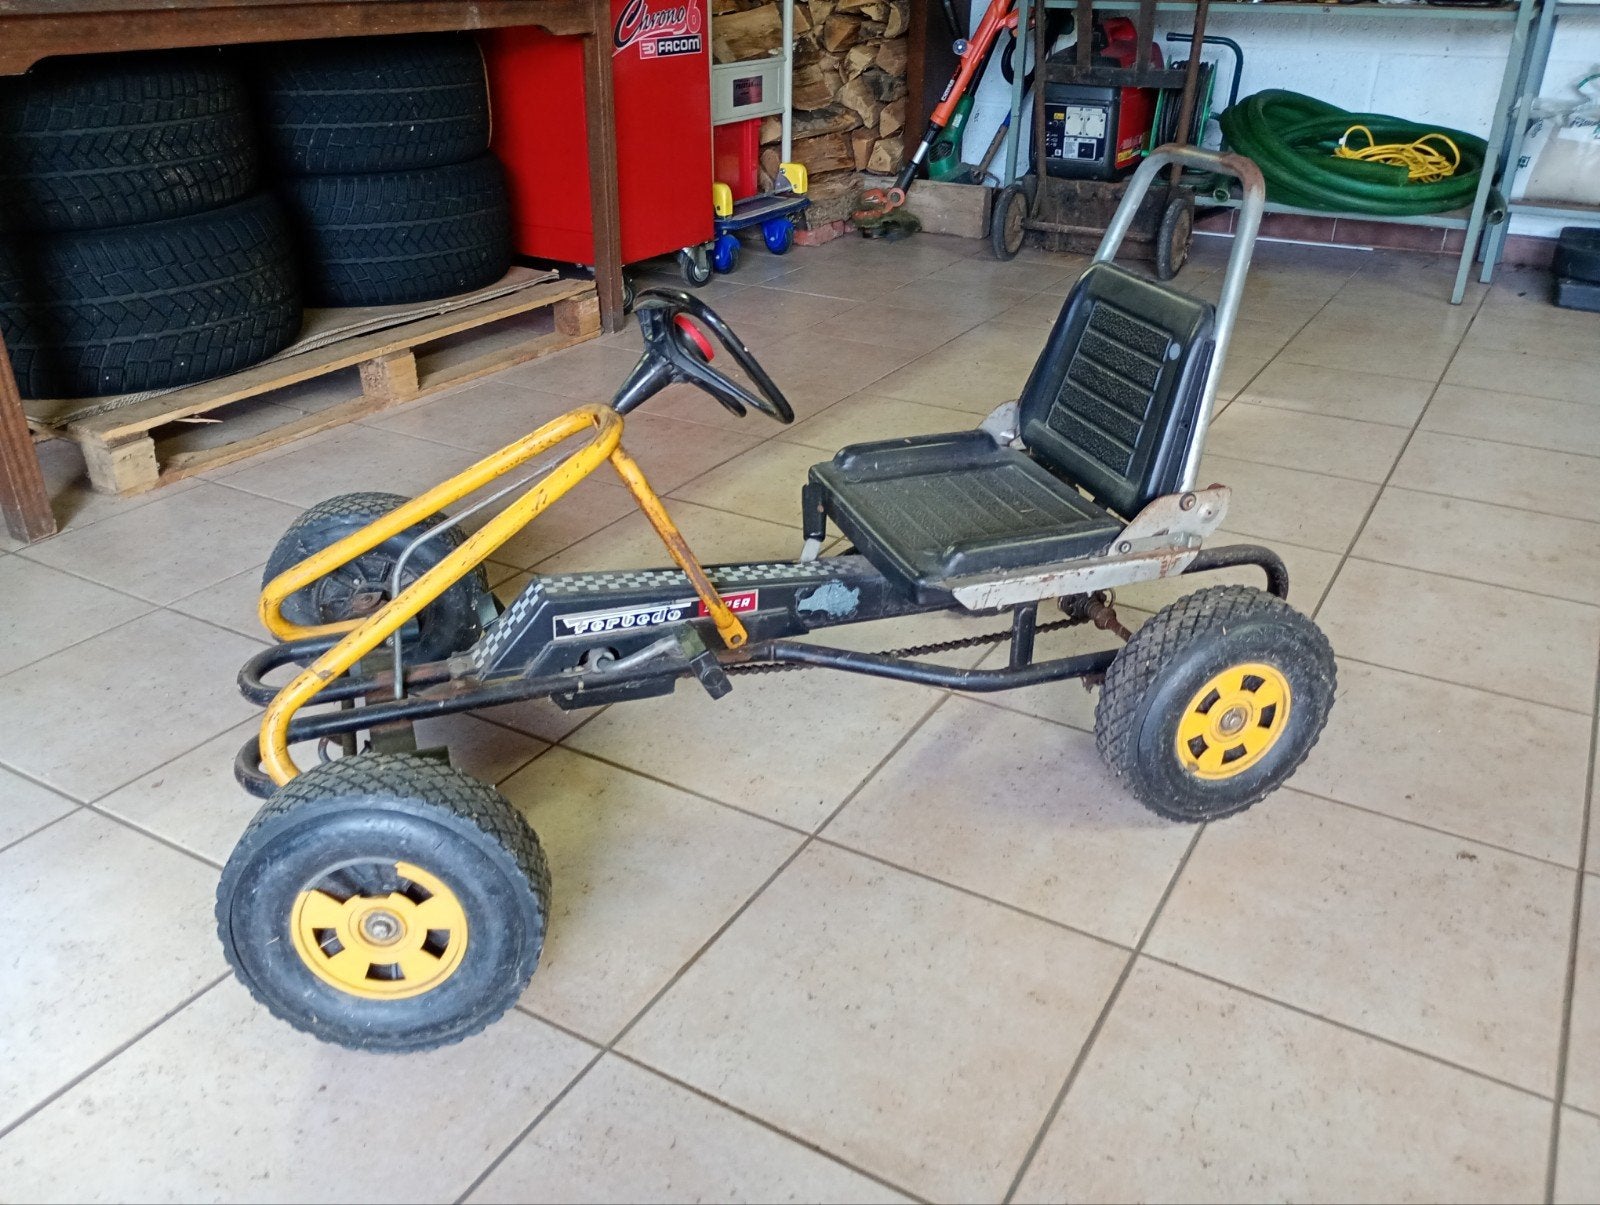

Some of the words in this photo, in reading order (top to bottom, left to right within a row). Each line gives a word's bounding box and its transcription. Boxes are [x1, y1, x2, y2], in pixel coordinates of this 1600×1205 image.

[613, 0, 686, 49] Chrono
[687, 0, 701, 34] 6
[658, 38, 700, 54] FACOM
[703, 597, 751, 613] PER
